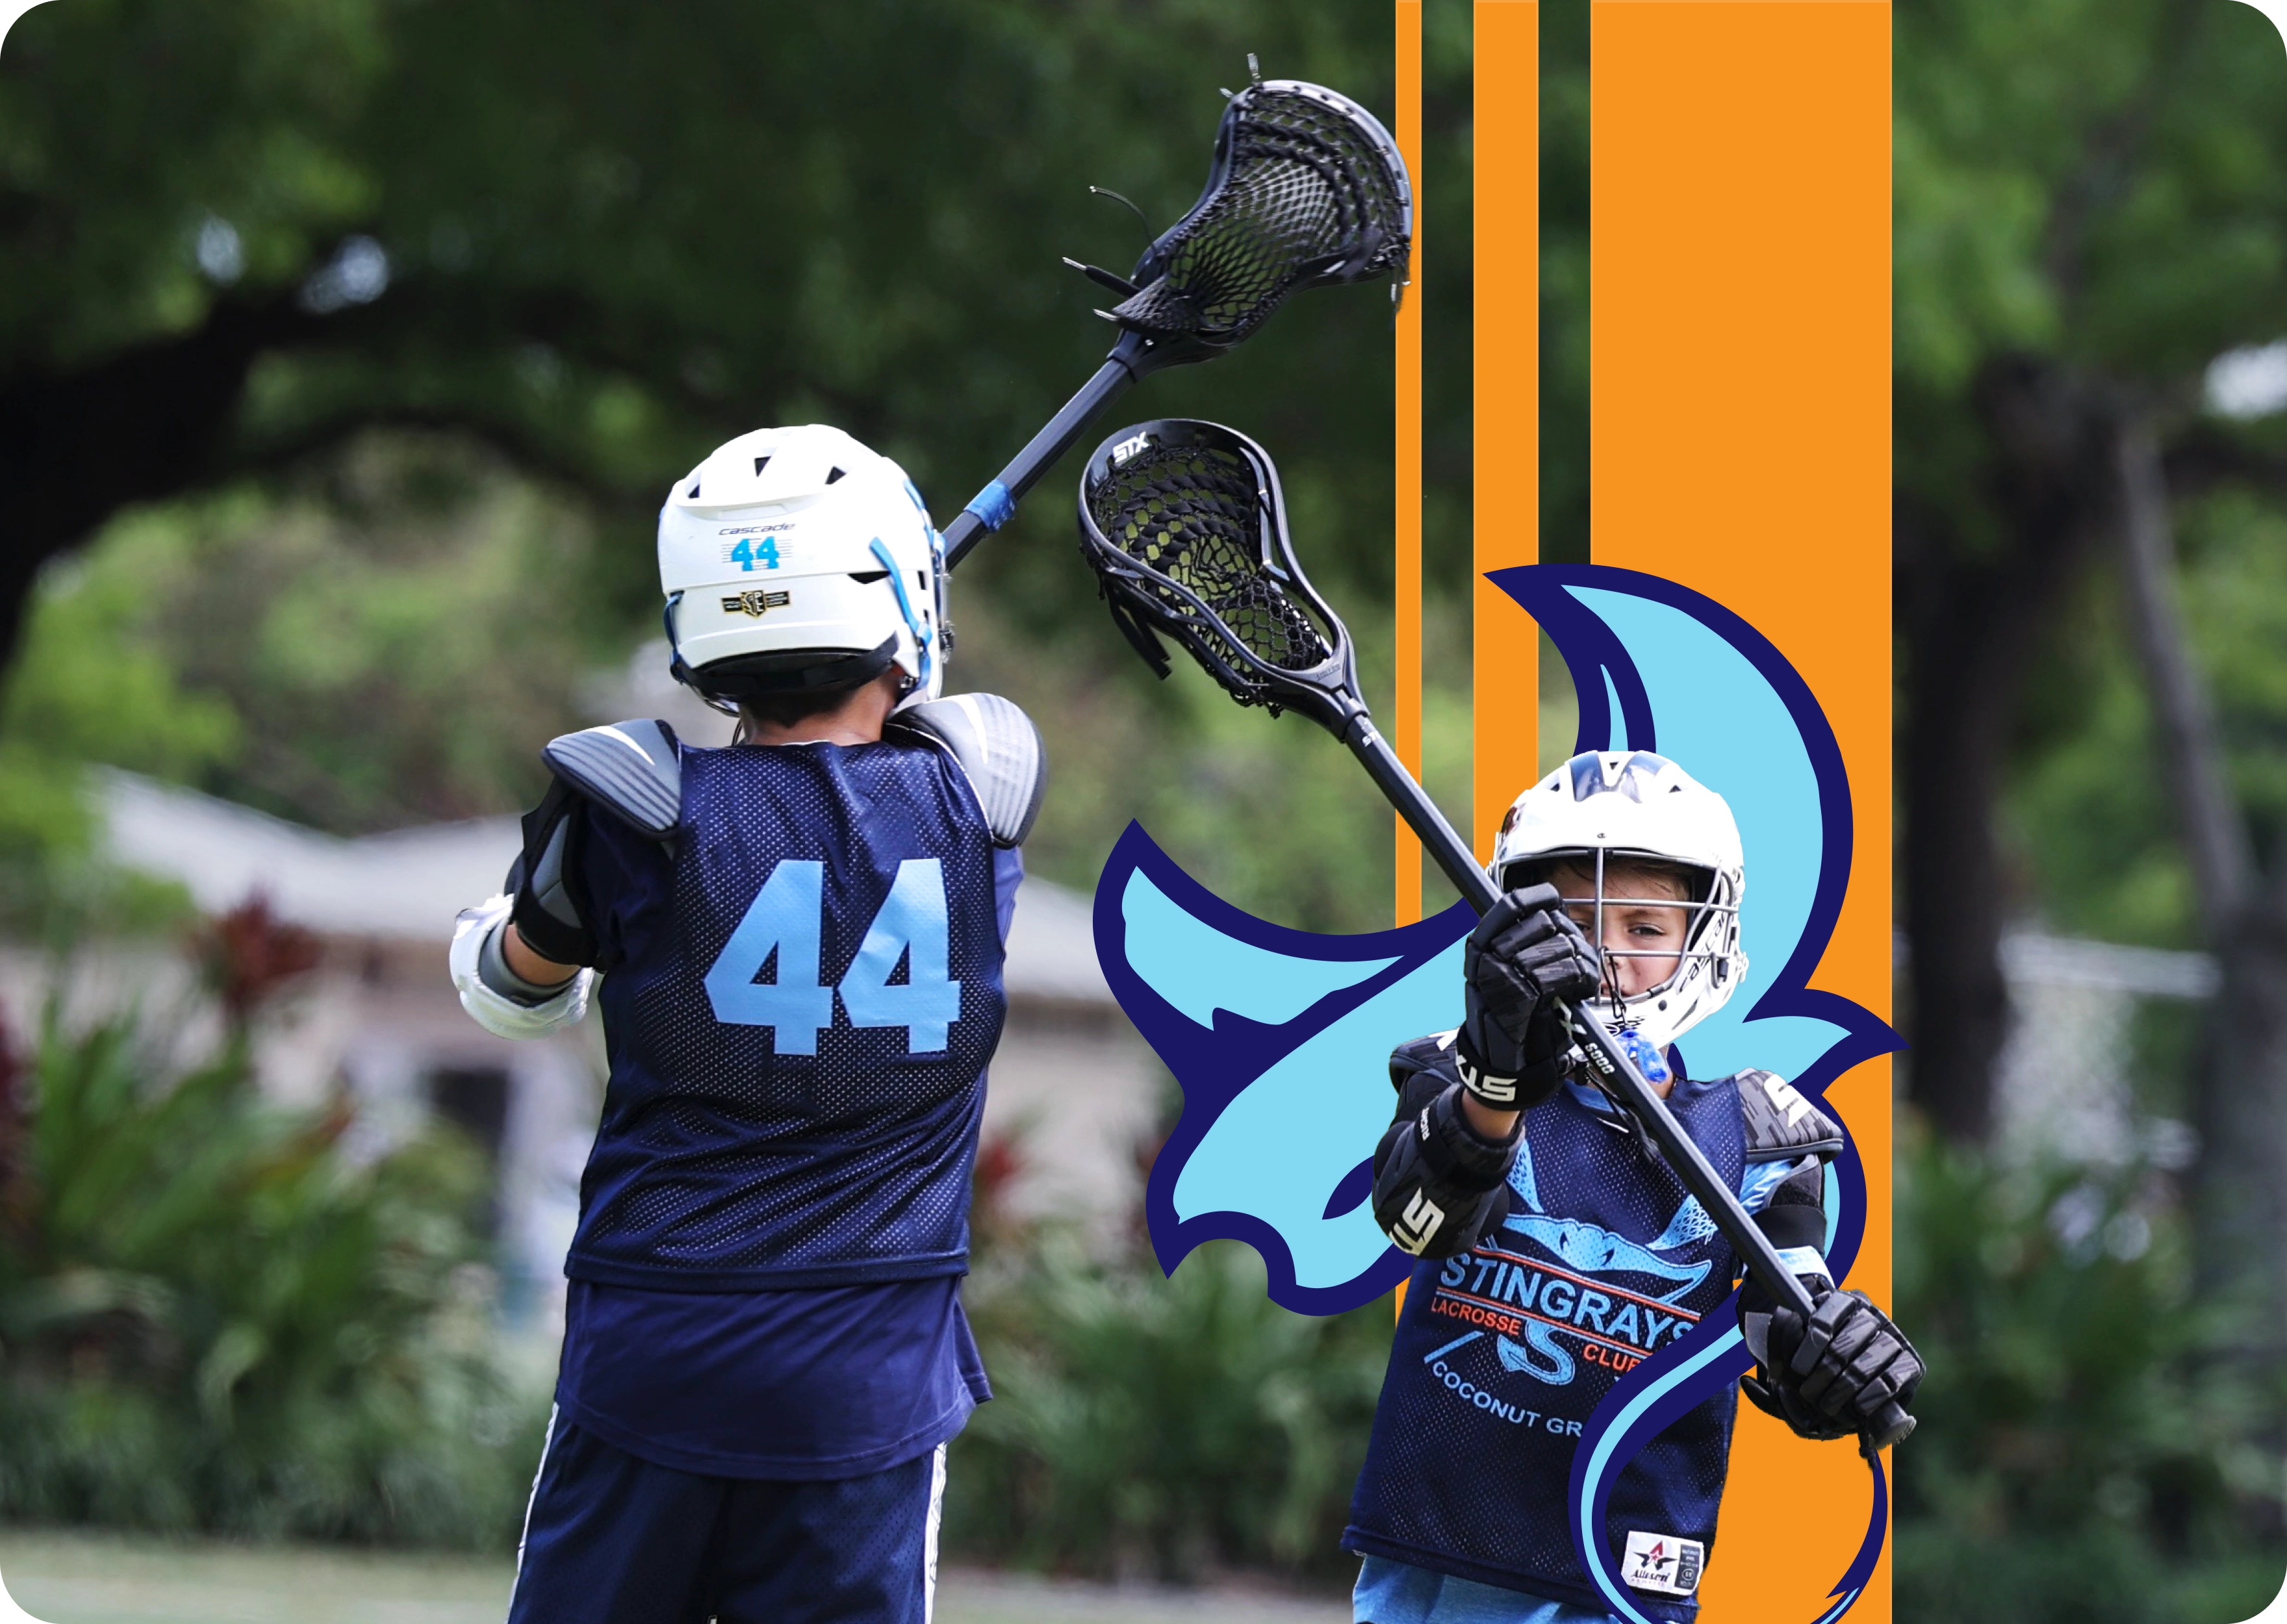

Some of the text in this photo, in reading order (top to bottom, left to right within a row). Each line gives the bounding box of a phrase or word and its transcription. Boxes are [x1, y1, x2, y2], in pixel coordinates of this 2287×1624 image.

[1113, 431, 1149, 463] STX
[719, 522, 796, 535] cascade
[731, 536, 780, 572] 44
[704, 857, 961, 1056] 44
[1431, 1297, 1522, 1336] LACROSSE
[1433, 1361, 1540, 1427] COCONUT
